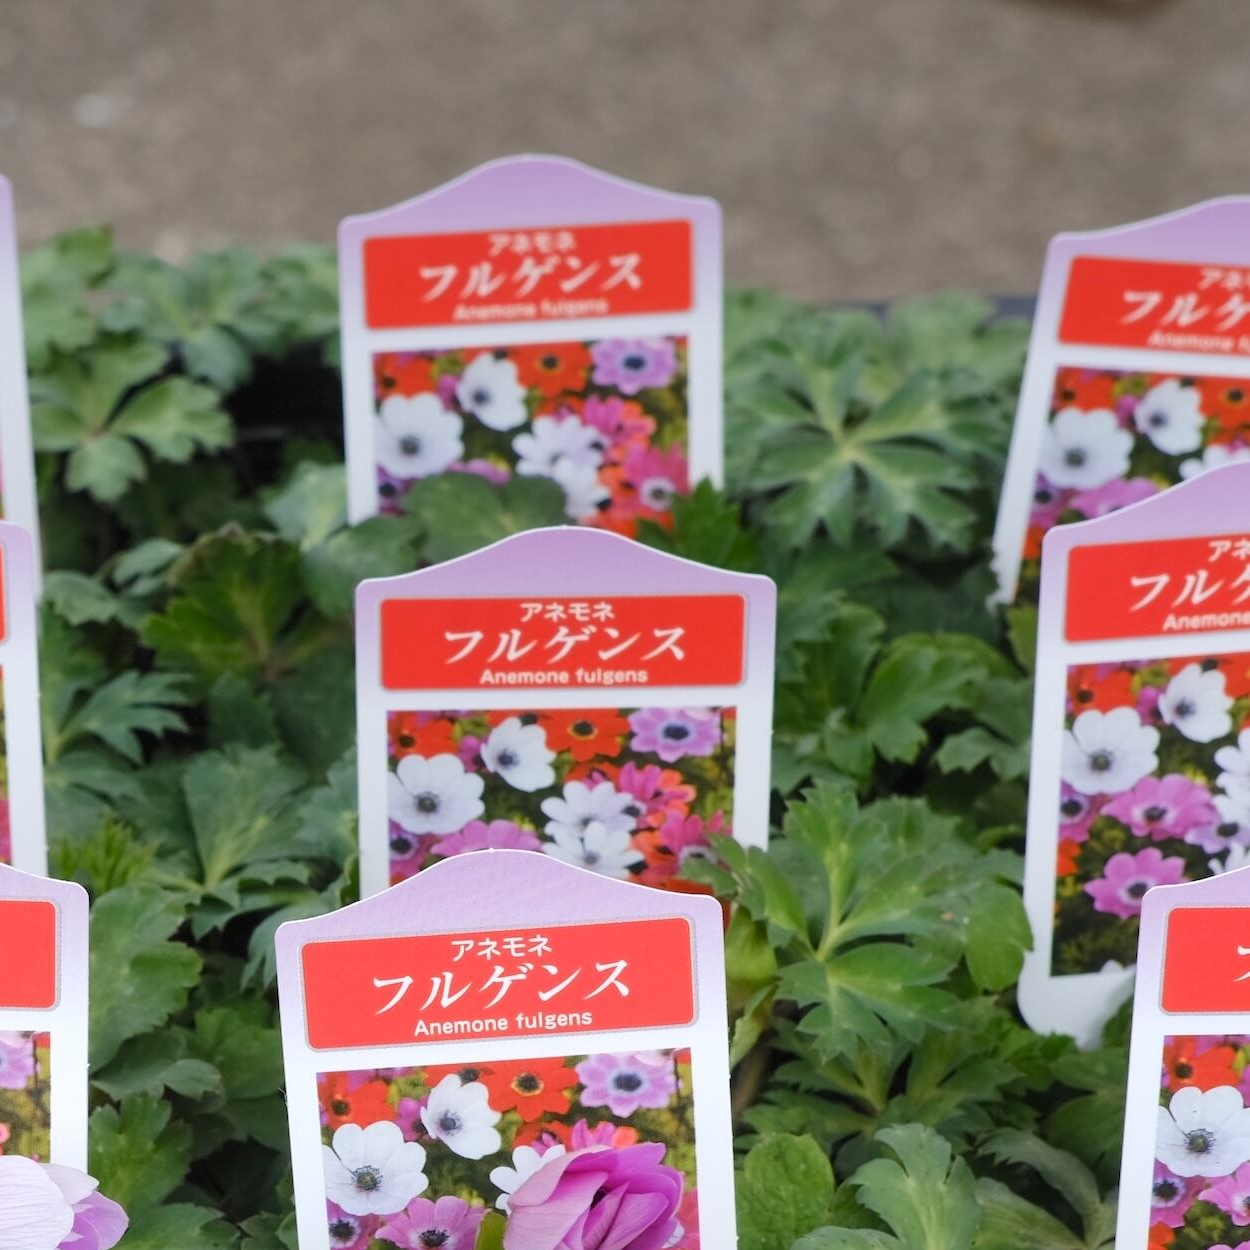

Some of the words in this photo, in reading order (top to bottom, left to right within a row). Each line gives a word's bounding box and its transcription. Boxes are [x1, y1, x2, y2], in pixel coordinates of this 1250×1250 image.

[490, 231, 575, 256] アネモネ
[420, 253, 641, 301] フルゲンス
[521, 602, 614, 622] アネモネ
[445, 625, 685, 663] フルゲンス
[480, 669, 569, 683] Anemone
[576, 668, 648, 684] fulgens
[451, 934, 552, 961] アネモネ
[373, 960, 629, 1014] フルゲンス
[414, 1018, 508, 1036] Anemone
[516, 1012, 593, 1030] fulgens
